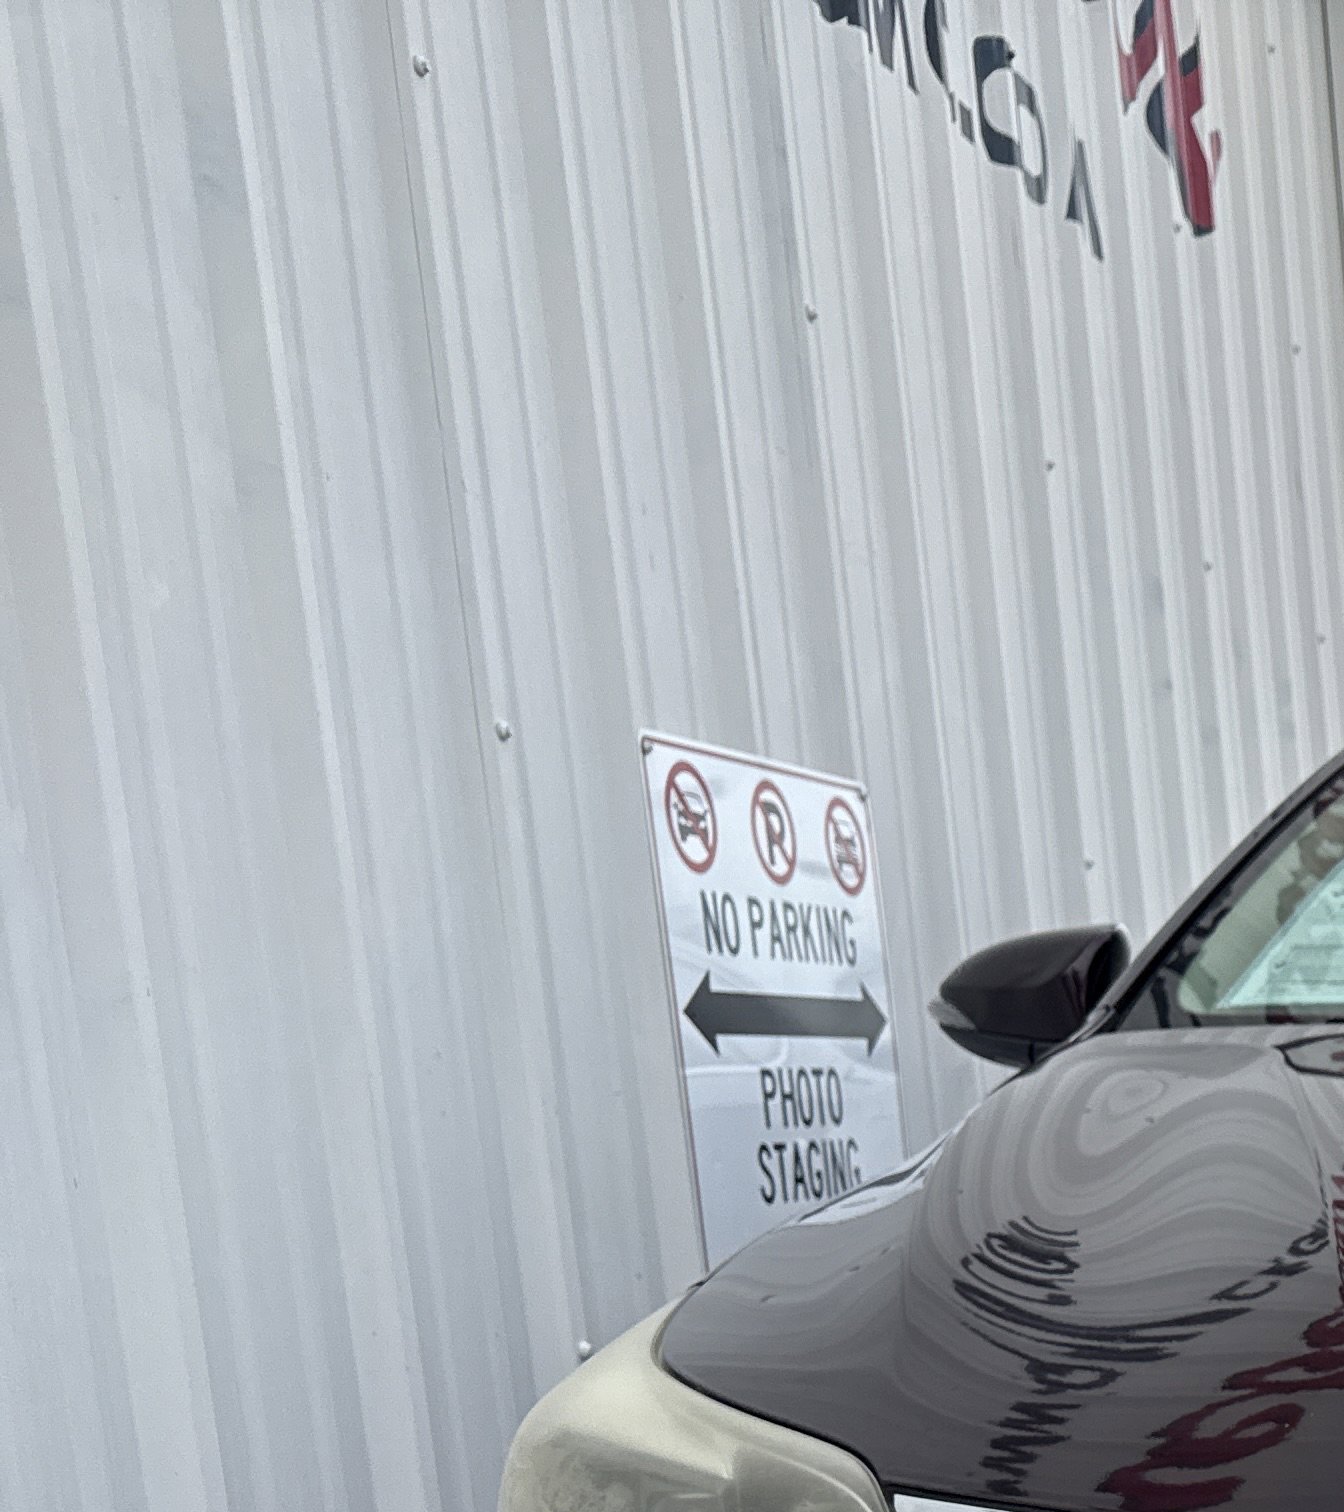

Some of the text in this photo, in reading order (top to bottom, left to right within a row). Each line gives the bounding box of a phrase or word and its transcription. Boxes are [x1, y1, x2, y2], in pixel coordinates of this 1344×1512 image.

[700, 889, 858, 967] NO PARKING
[760, 1066, 844, 1129] PHOTO
[758, 1136, 862, 1204] STAGING
